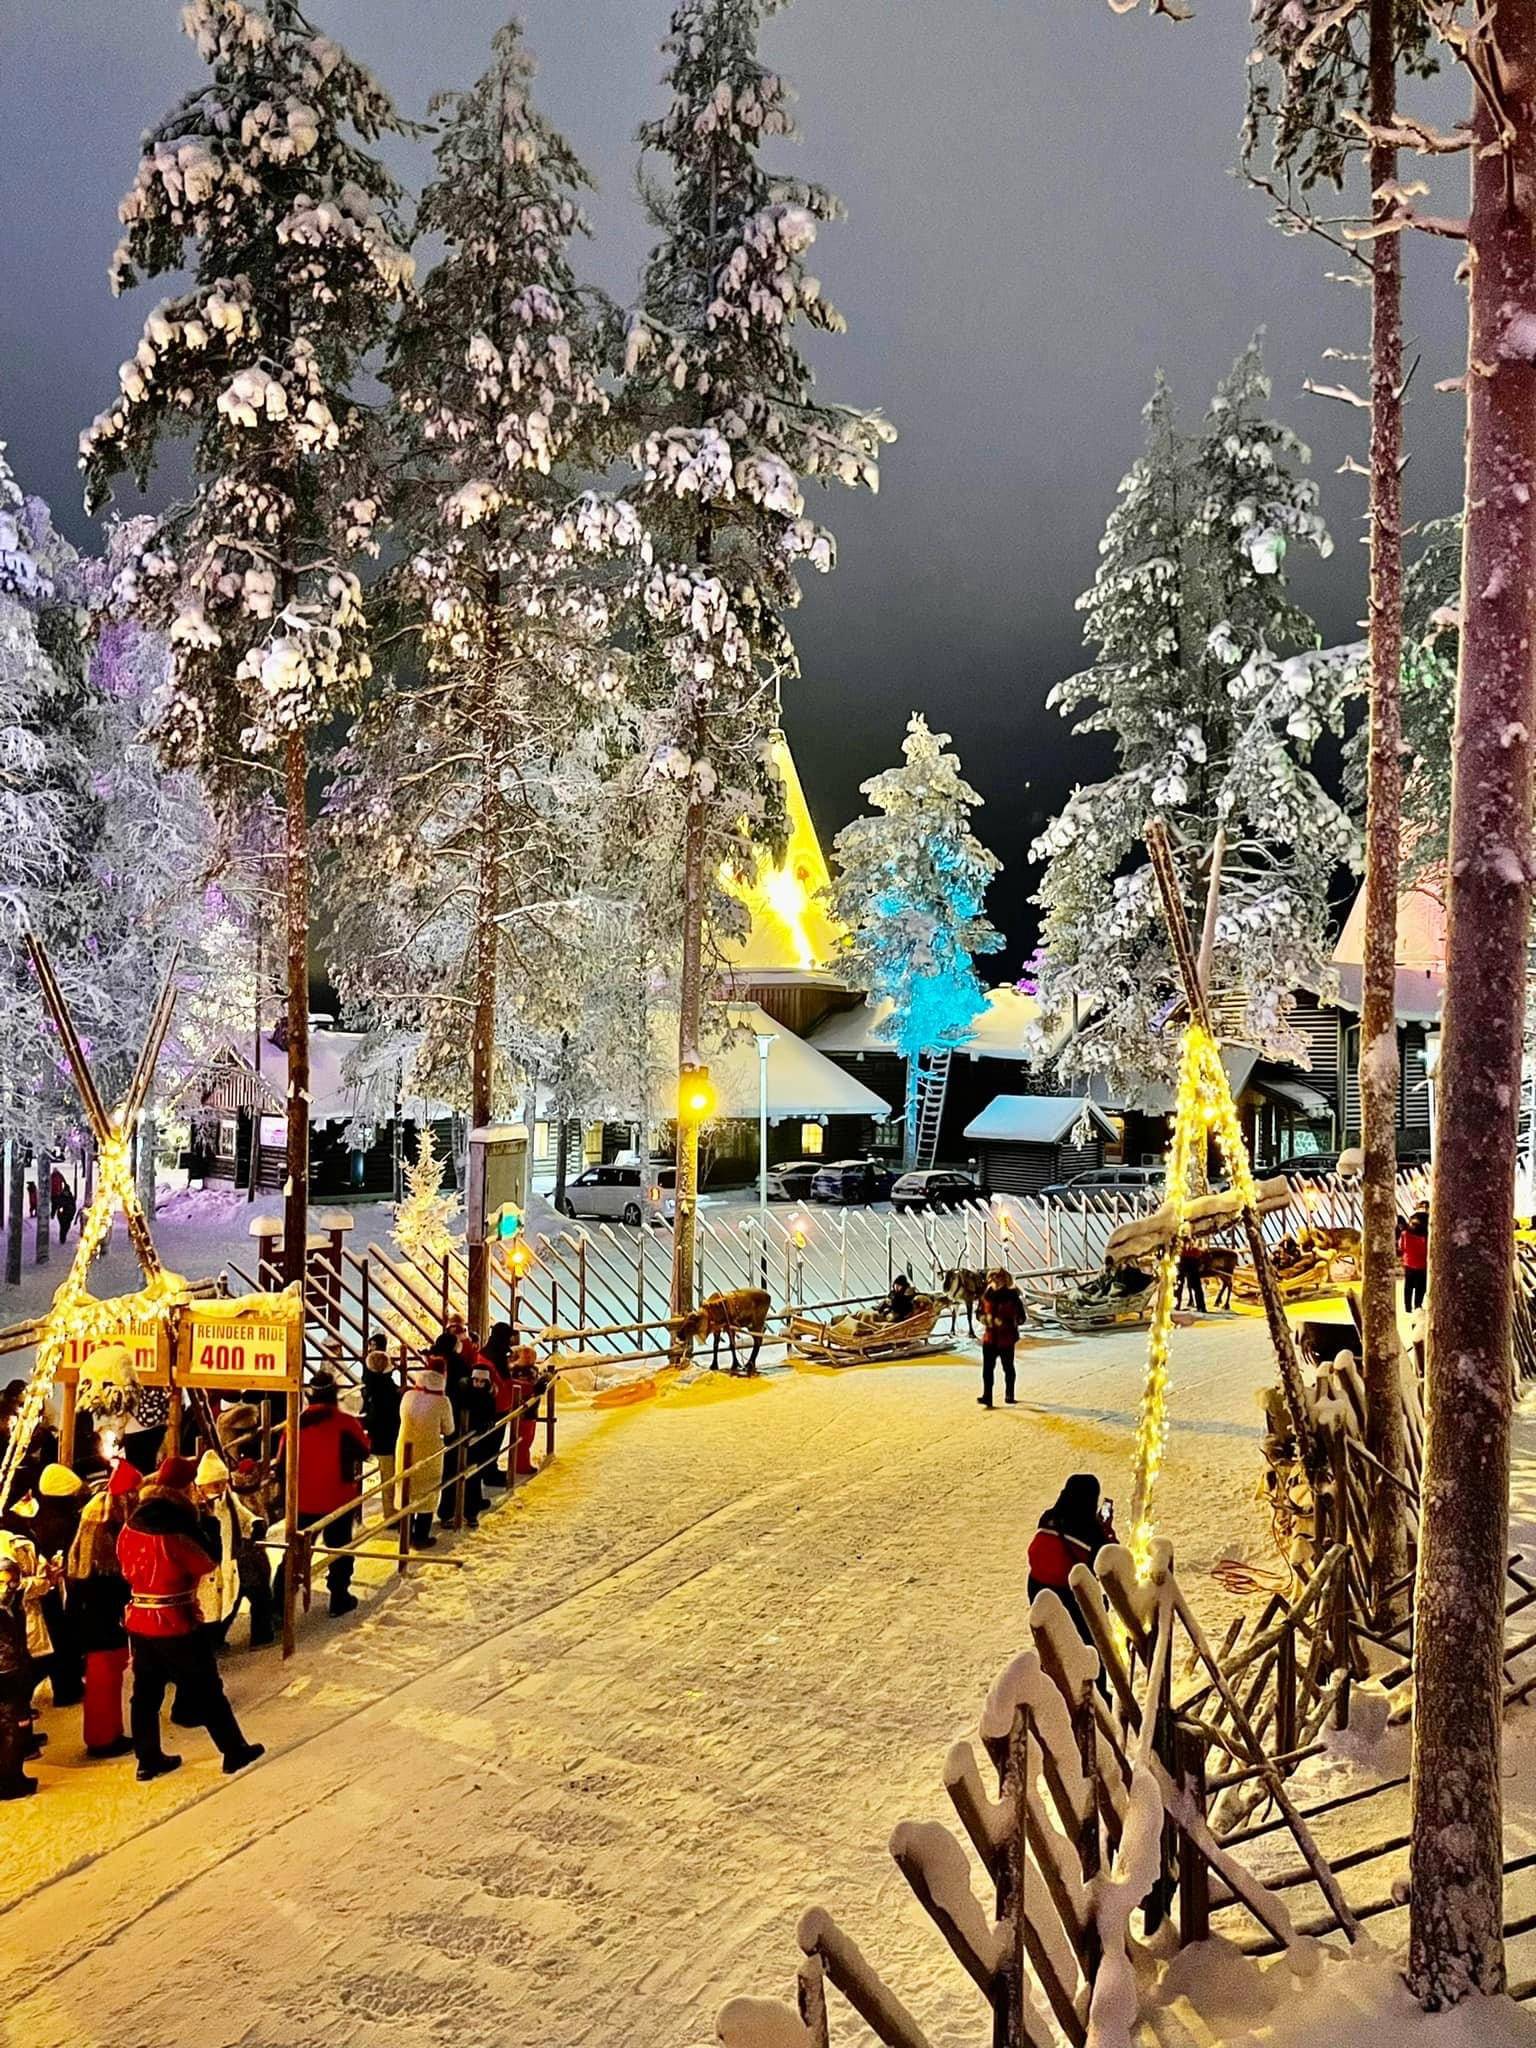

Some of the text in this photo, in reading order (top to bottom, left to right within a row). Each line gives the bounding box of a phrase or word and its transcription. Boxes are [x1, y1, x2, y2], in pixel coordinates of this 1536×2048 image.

[130, 1319, 155, 1337] RIDE
[198, 1325, 285, 1342] REINDEER RIDE
[69, 1339, 155, 1368] 10 m
[200, 1344, 276, 1371] 400 m
